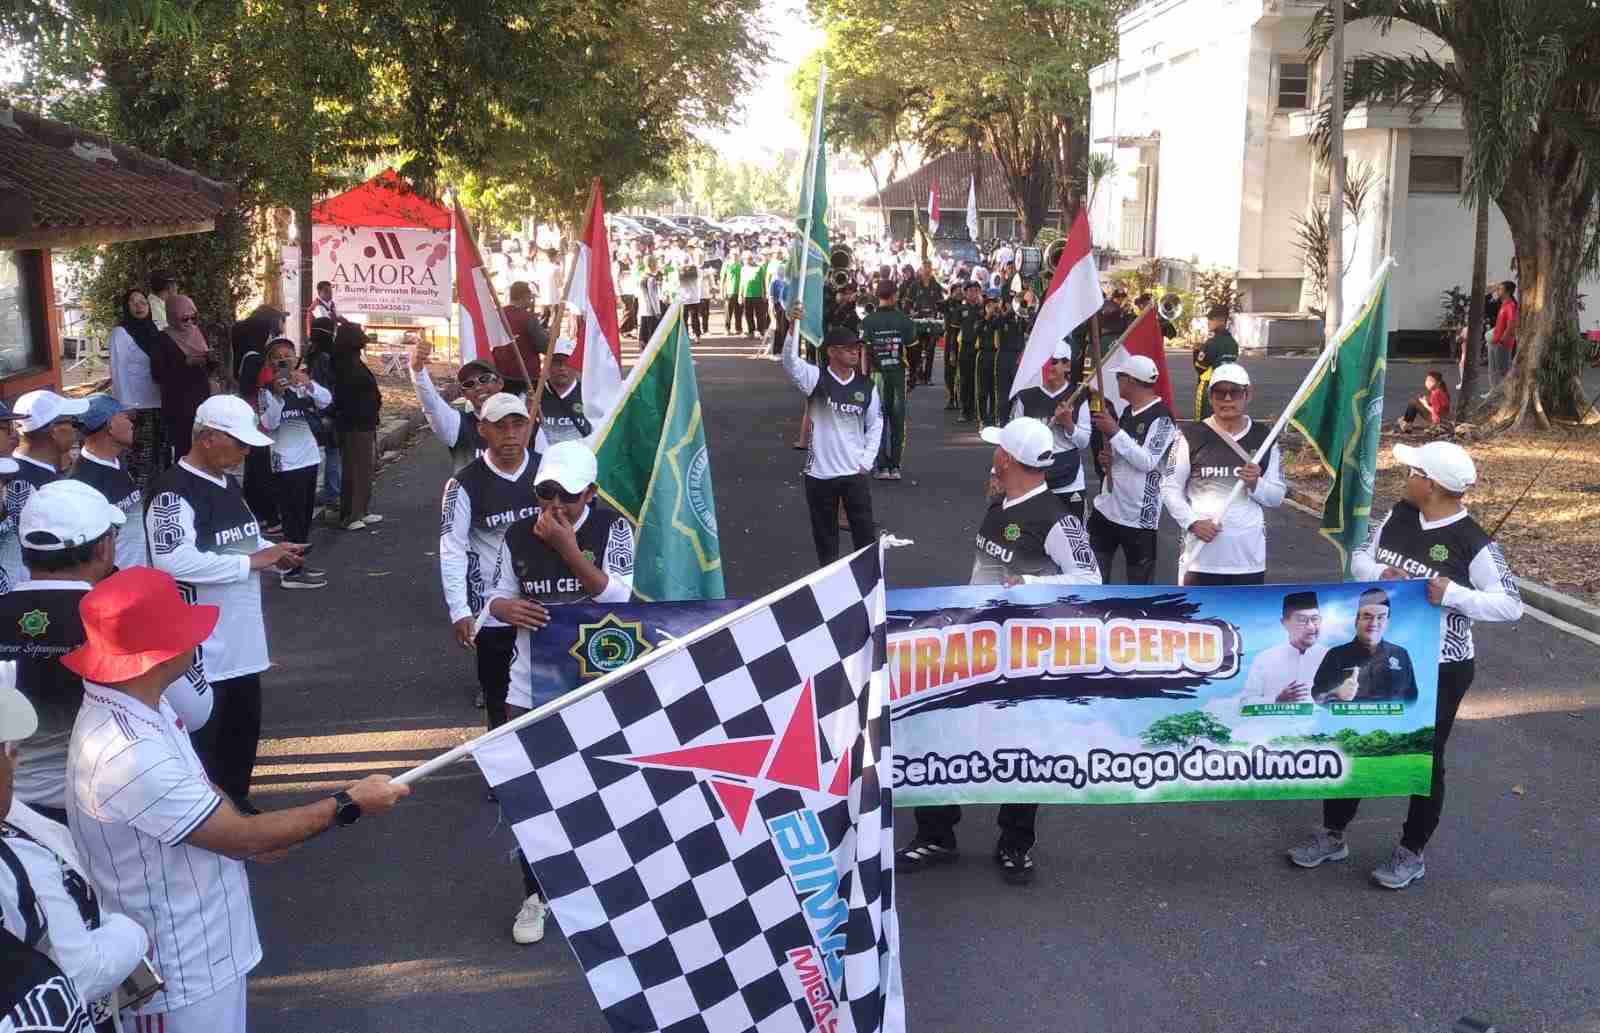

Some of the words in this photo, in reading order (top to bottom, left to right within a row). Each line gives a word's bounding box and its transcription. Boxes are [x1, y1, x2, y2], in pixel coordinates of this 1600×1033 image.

[331, 264, 438, 286] AMORA
[369, 286, 409, 295] Permata
[410, 287, 439, 297] Realty
[1200, 466, 1229, 478] IPHI
[486, 510, 515, 528] IPHI
[215, 525, 243, 547] IPHI
[986, 540, 1014, 563] CEPU
[1377, 547, 1402, 569] IPHI
[1403, 557, 1441, 579] CEPU
[522, 579, 552, 594] IPHI
[1009, 625, 1097, 671] IPHI
[1108, 625, 1218, 665] CEPU
[996, 750, 1086, 787] Jiwa,
[1090, 750, 1176, 787] Raga
[1181, 747, 1249, 779] dan
[1253, 746, 1341, 778] Iman
